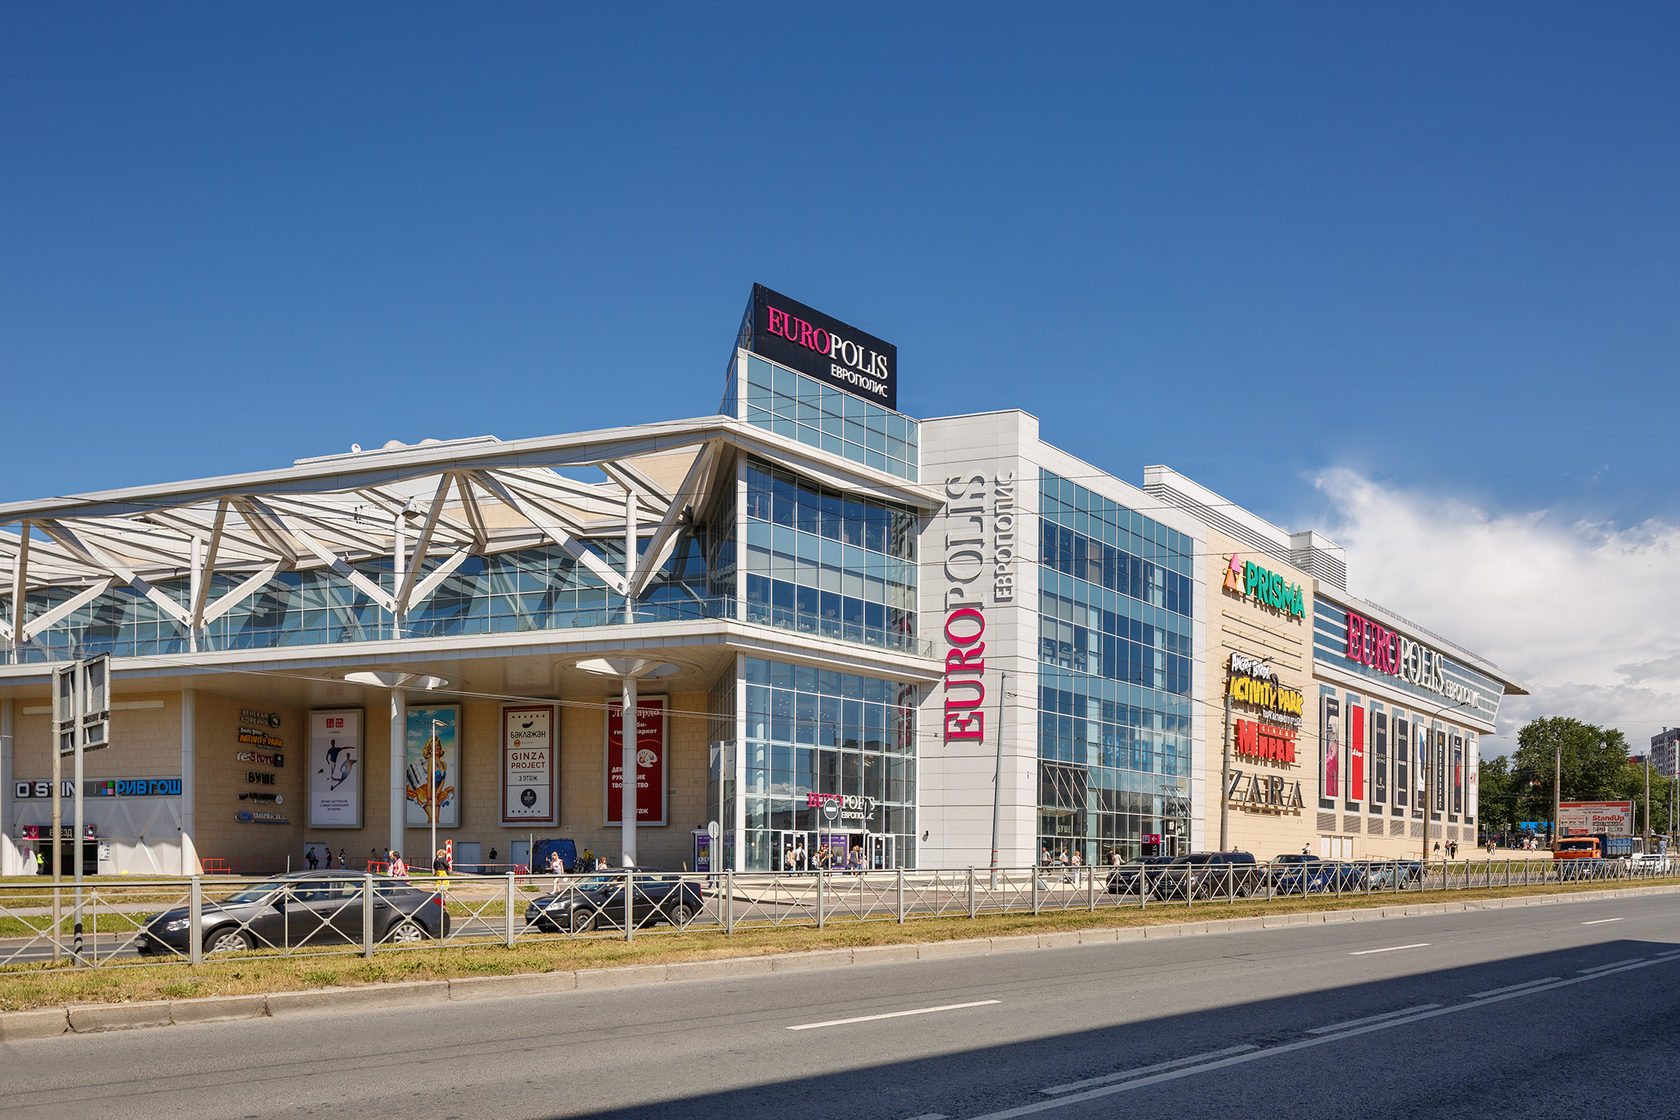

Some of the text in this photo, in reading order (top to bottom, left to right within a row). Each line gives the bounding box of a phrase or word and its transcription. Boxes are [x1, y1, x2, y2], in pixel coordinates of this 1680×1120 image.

[766, 305, 889, 380] EUROPOLIS
[830, 363, 888, 398] ЕВРОПОЛИС
[994, 470, 1014, 603] ЕВРОПОЛИС
[1246, 560, 1306, 620] PRISMA
[944, 474, 987, 747] EUROPOLIS
[1346, 611, 1445, 694] EUROPOLIS
[1230, 676, 1304, 716] ACTIVITY PARK
[1261, 725, 1295, 739] CINEMA
[511, 752, 545, 760] GINZA
[511, 761, 546, 769] PROJECT
[16, 781, 76, 798] O'SIN
[117, 779, 182, 795] РИВГОШ
[248, 771, 276, 785] БУШЕ
[1229, 768, 1306, 809] ZARA
[1592, 814, 1625, 823] StandUp
